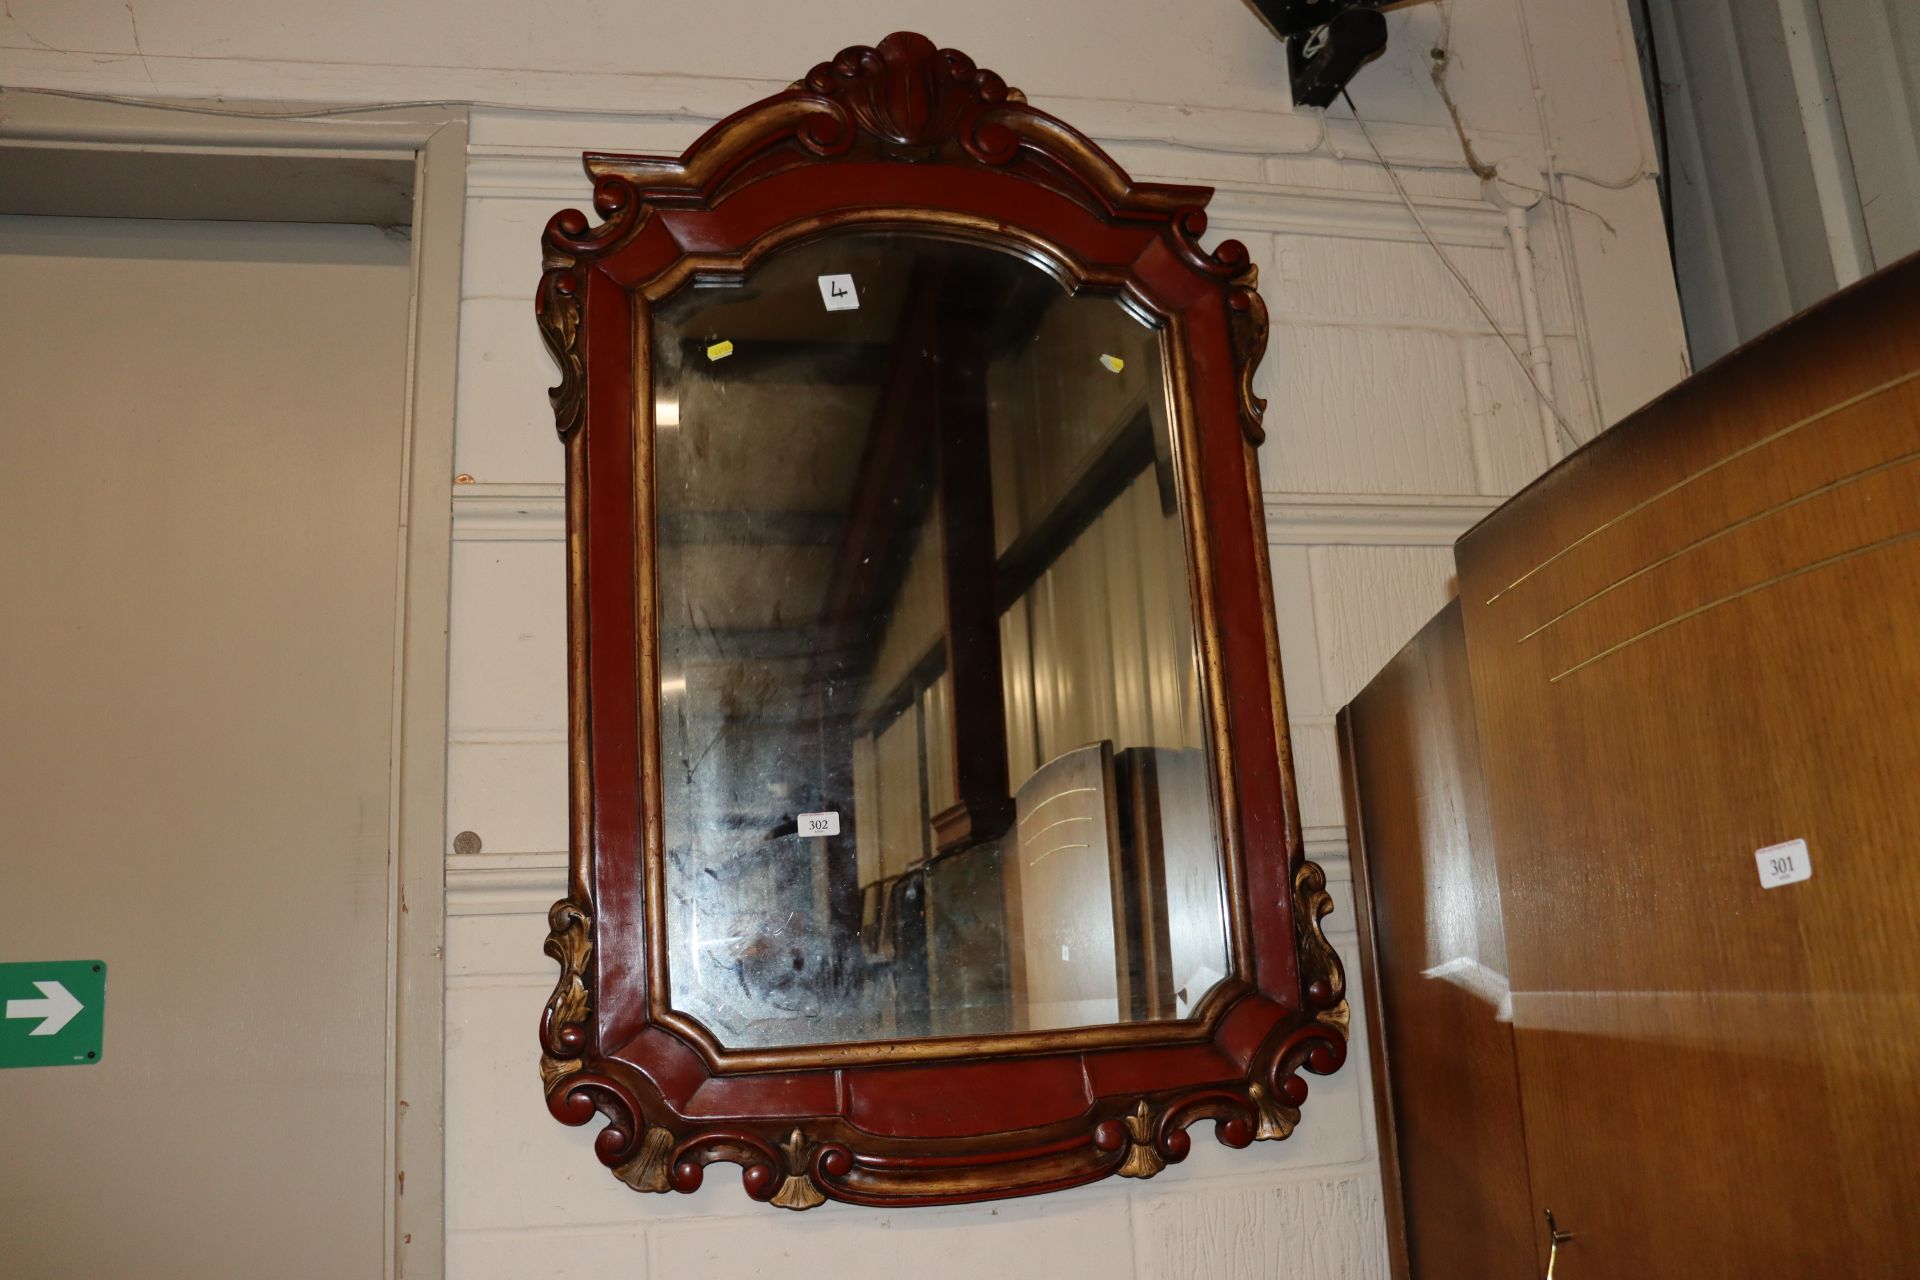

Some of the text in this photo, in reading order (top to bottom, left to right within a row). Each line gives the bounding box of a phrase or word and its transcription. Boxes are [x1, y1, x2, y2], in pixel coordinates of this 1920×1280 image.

[831, 280, 848, 298] 4
[808, 819, 829, 831] 302
[1770, 856, 1794, 876] 301
